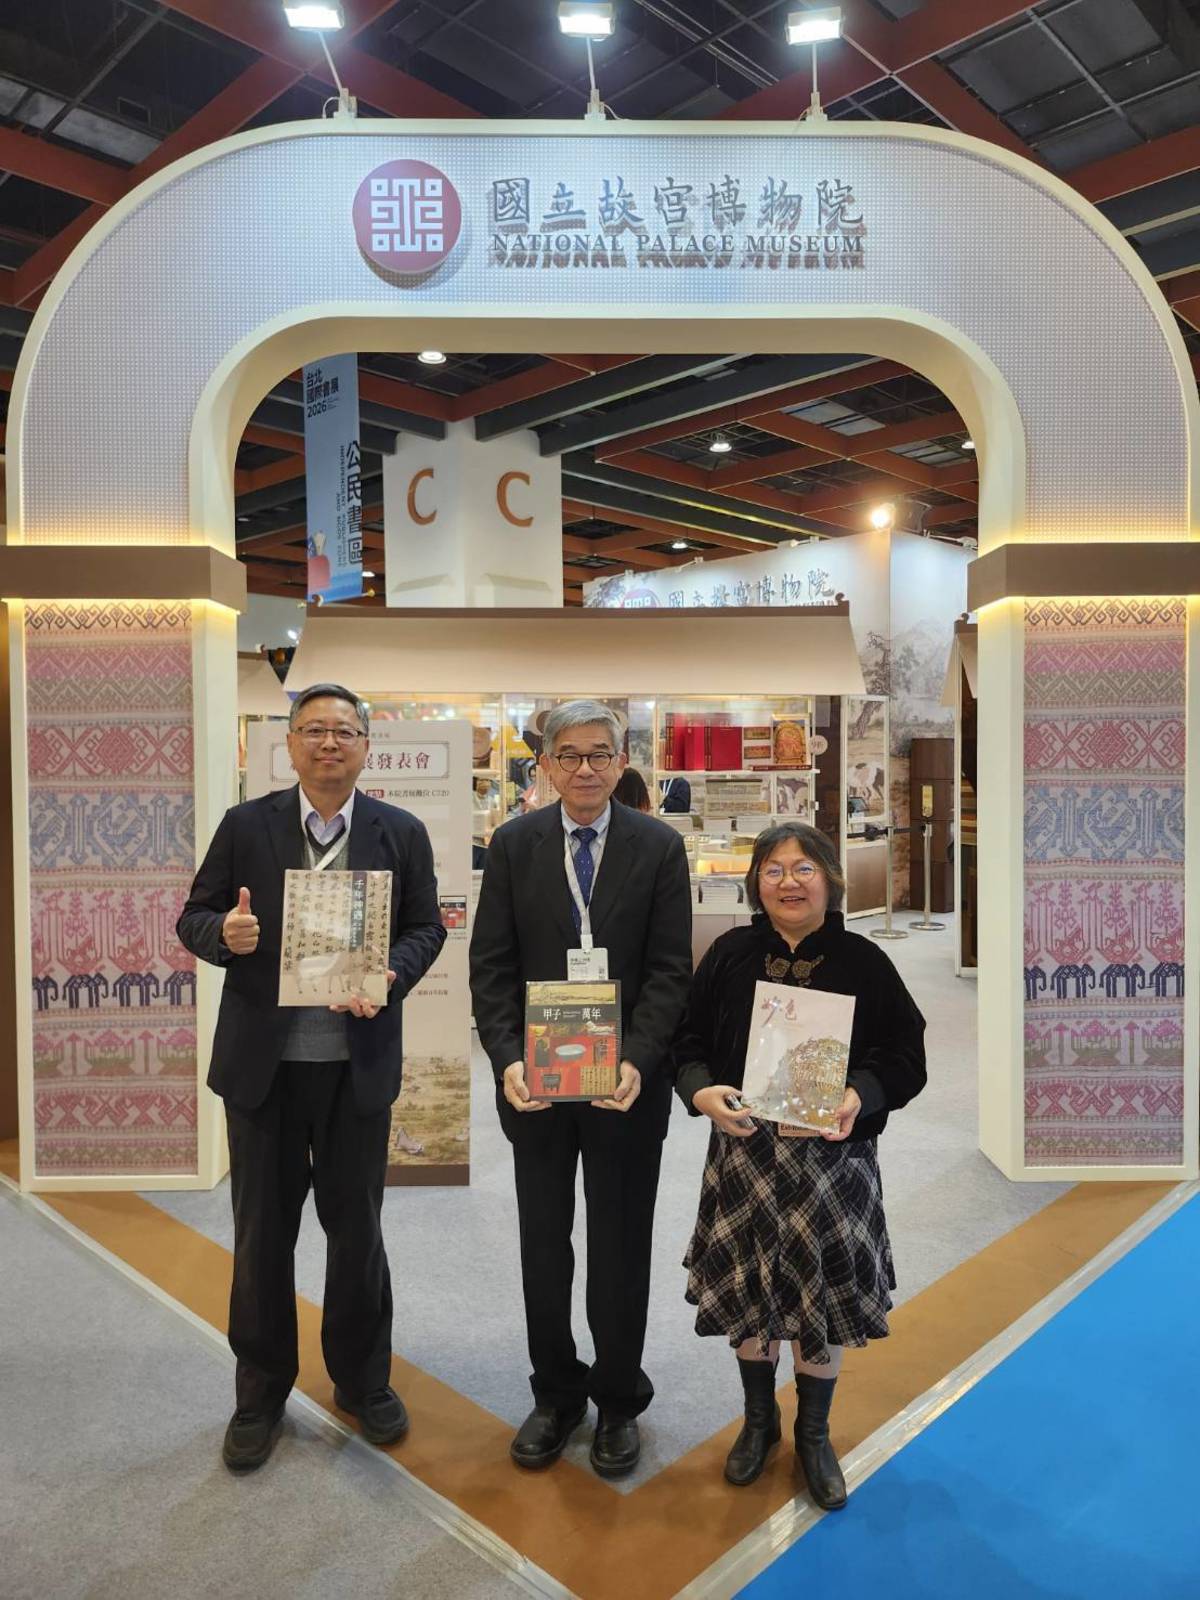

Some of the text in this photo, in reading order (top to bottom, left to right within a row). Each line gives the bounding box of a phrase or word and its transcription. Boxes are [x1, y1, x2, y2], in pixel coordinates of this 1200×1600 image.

[492, 174, 864, 227] 國立故宮博物院
[492, 234, 863, 253] NATIONAL PALACE MUSEUM
[307, 401, 327, 418] 2026
[407, 468, 438, 526] C
[496, 471, 534, 527] C
[543, 1008, 561, 1021] 甲子
